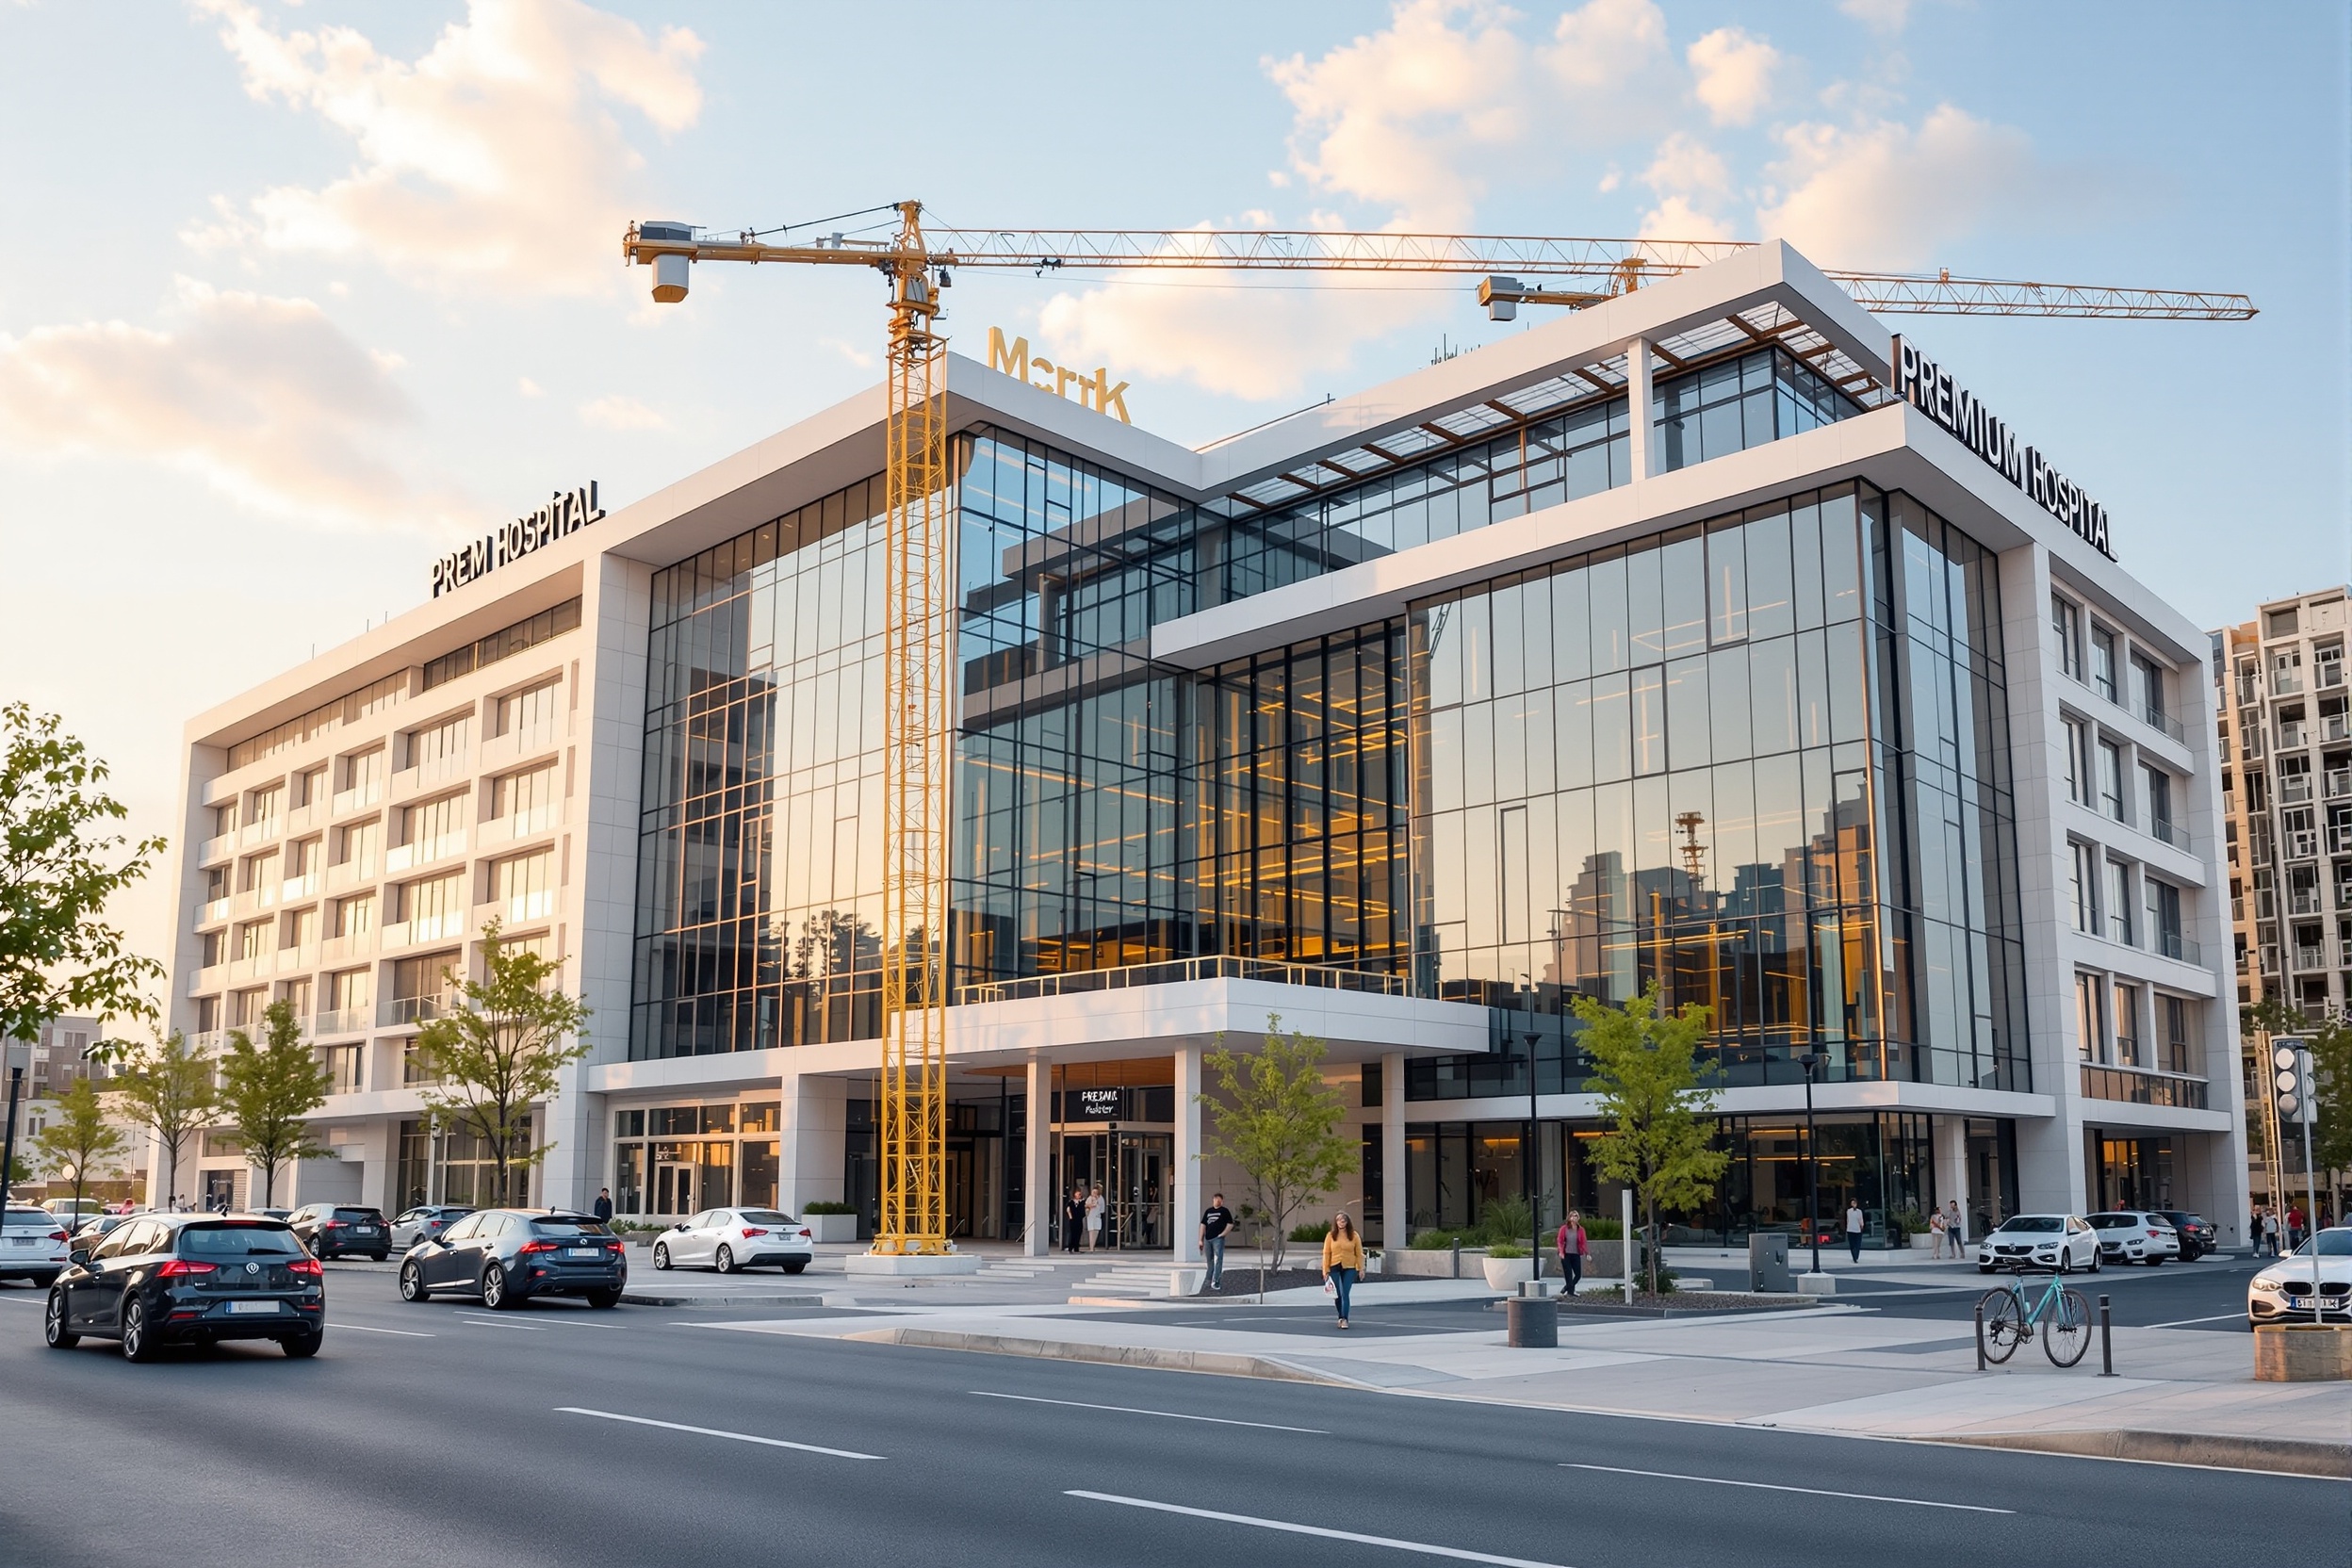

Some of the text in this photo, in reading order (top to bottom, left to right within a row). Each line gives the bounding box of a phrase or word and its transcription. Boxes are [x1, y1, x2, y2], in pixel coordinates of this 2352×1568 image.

[1890, 333, 2028, 494] PREMIUM
[432, 480, 607, 599] PREM HOSPITAL
